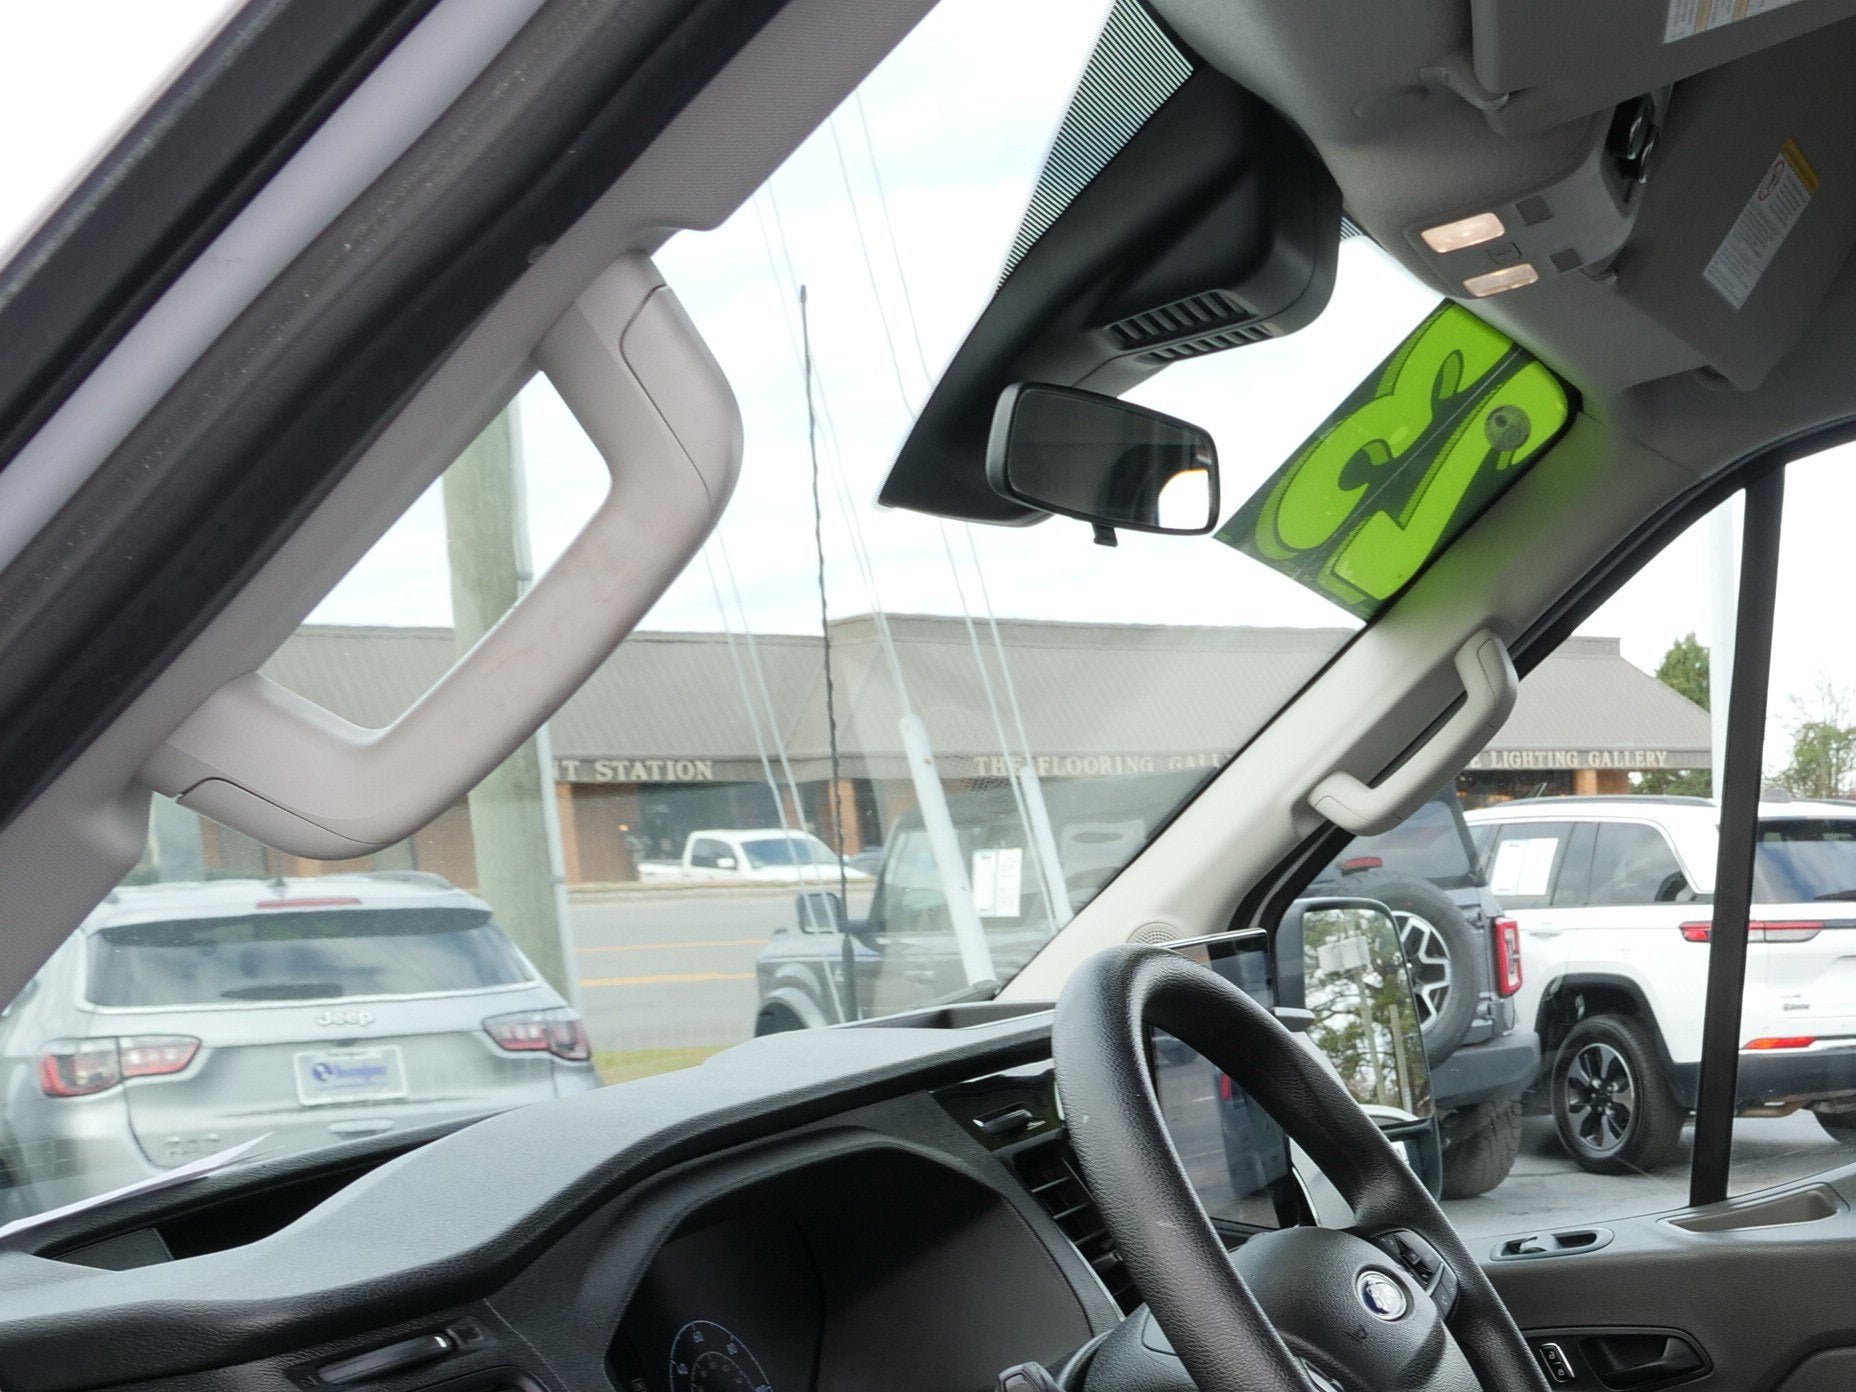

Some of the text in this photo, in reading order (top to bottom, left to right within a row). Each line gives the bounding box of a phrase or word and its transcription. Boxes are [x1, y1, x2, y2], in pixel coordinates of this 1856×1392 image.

[1036, 755, 1155, 777] FLOORING
[1490, 750, 1578, 769] LIGHTING
[1588, 750, 1668, 769] GALLERY
[593, 759, 713, 782] STATION
[317, 1010, 374, 1027] Jeep
